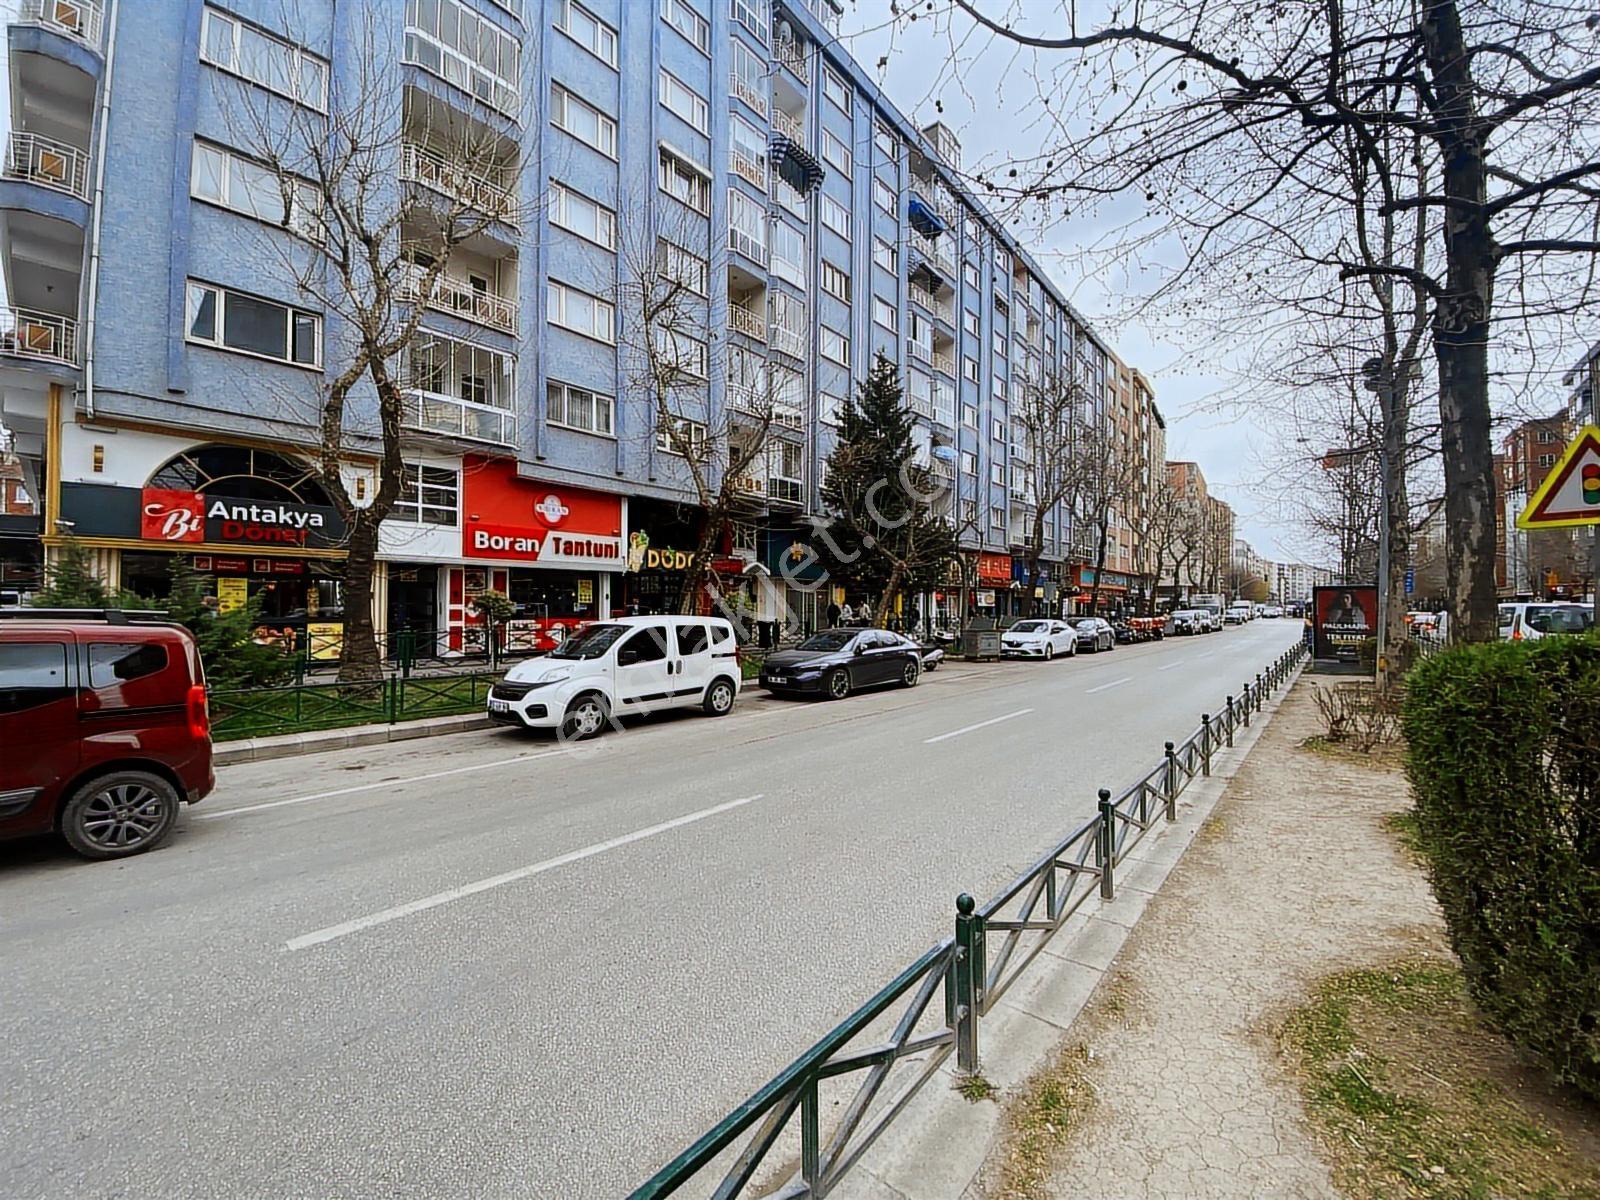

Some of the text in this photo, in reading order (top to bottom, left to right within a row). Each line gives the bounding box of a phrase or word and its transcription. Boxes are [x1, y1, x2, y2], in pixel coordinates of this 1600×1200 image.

[144, 503, 201, 540] Bi
[208, 501, 323, 528] Antakya
[223, 521, 310, 543] Döner
[474, 530, 620, 559] Boran Tantuni
